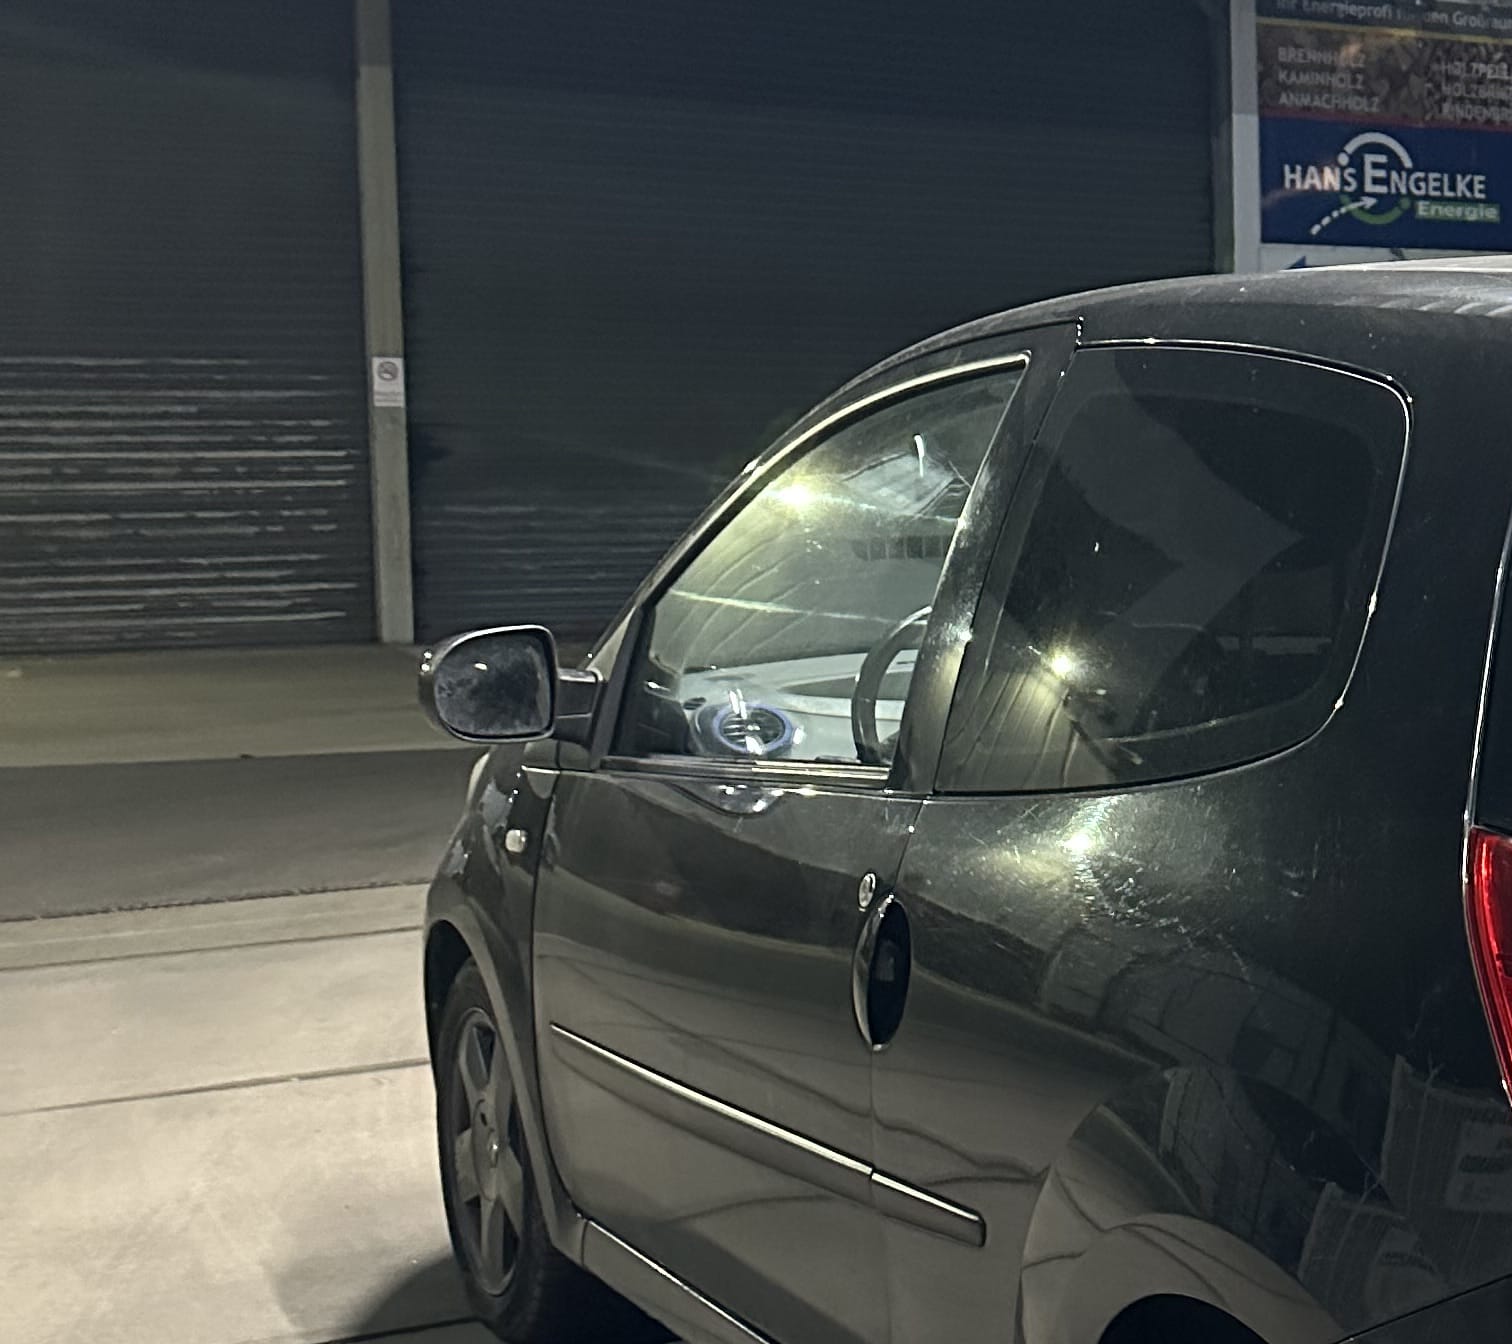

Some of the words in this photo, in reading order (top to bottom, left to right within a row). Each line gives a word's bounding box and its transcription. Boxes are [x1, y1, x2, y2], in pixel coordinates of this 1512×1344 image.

[1278, 69, 1365, 89] KAMINHOLZ
[1283, 164, 1357, 192] HANS
[1364, 153, 1487, 199] ENGELKE
[1417, 202, 1498, 221] Energie
